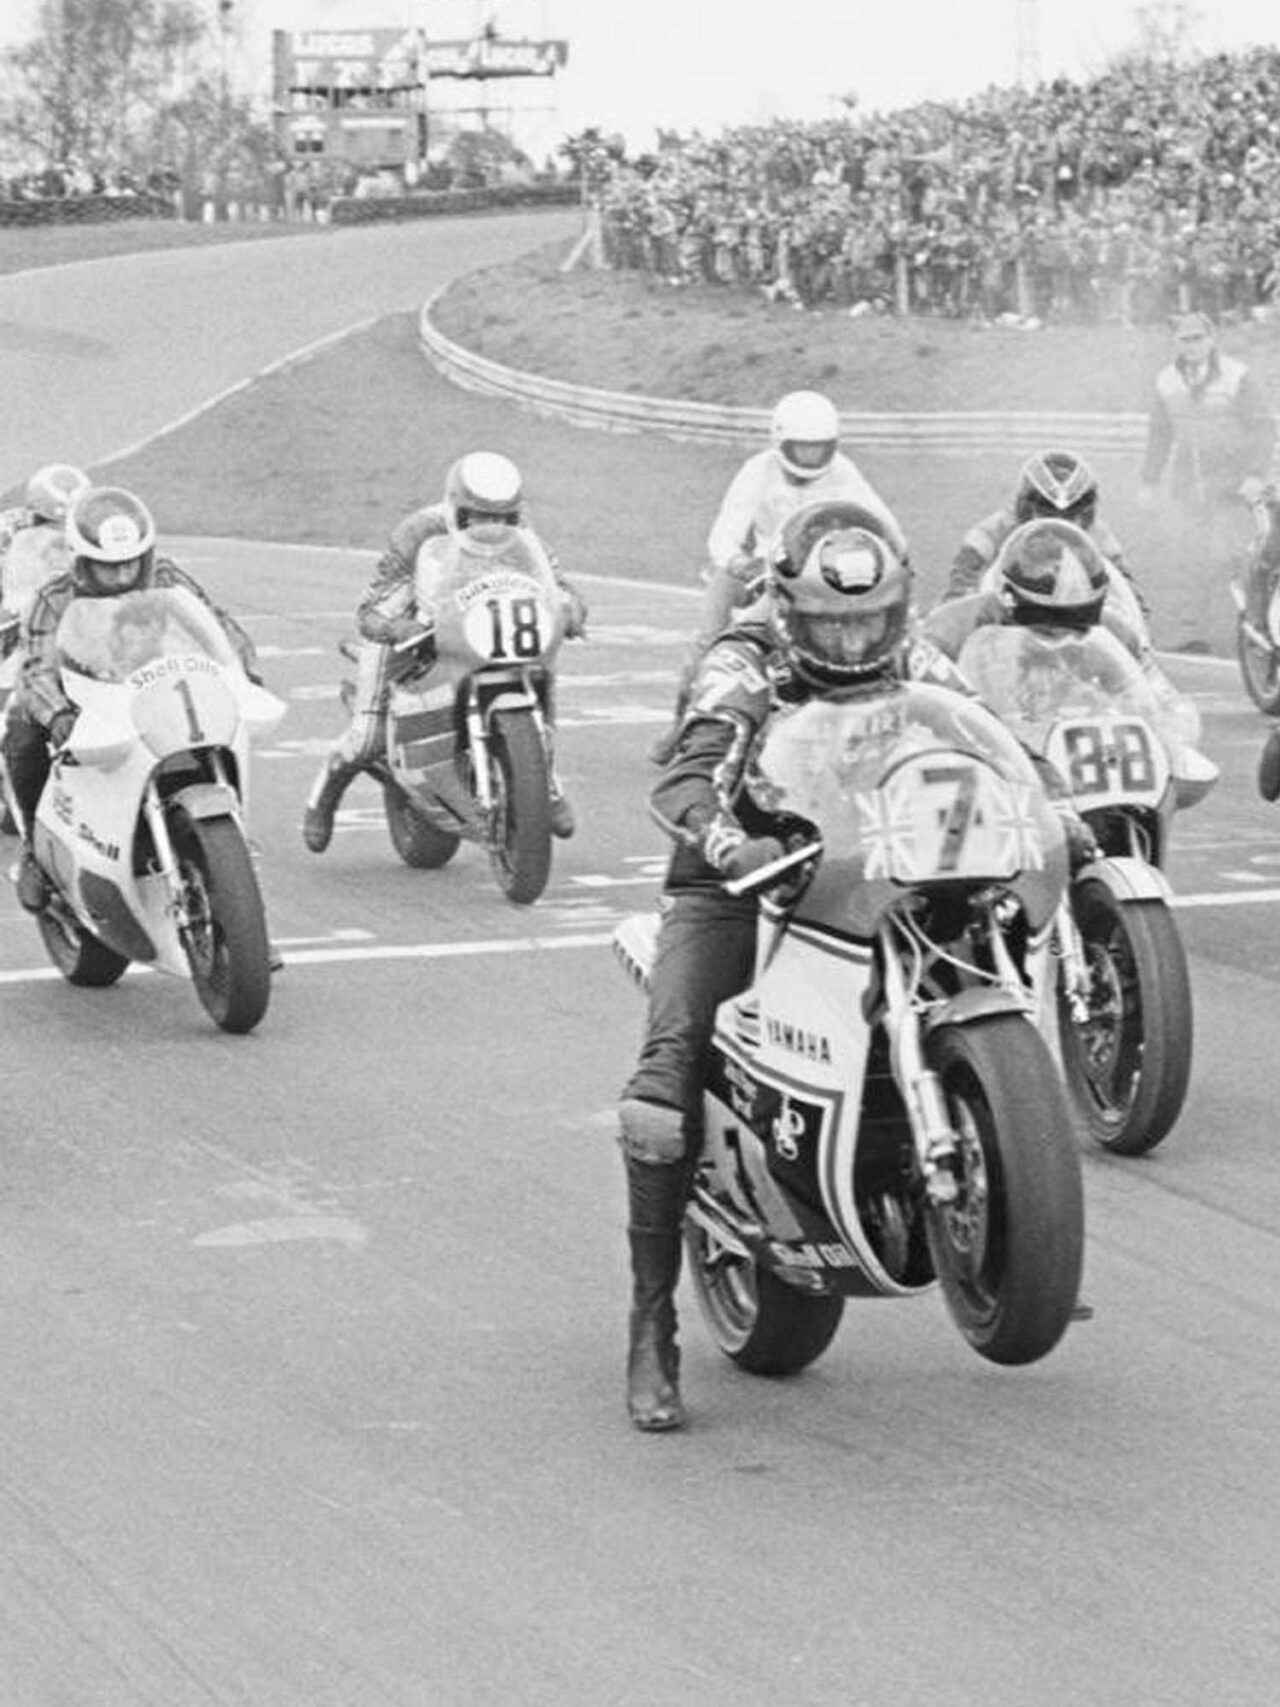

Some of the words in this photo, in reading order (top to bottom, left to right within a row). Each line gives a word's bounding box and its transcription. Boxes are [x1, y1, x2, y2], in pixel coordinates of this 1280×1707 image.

[486, 599, 540, 658] 18
[172, 679, 206, 743] 1
[1063, 724, 1155, 797] 88
[921, 766, 976, 871] 7
[765, 1015, 832, 1067] YAMAHA
